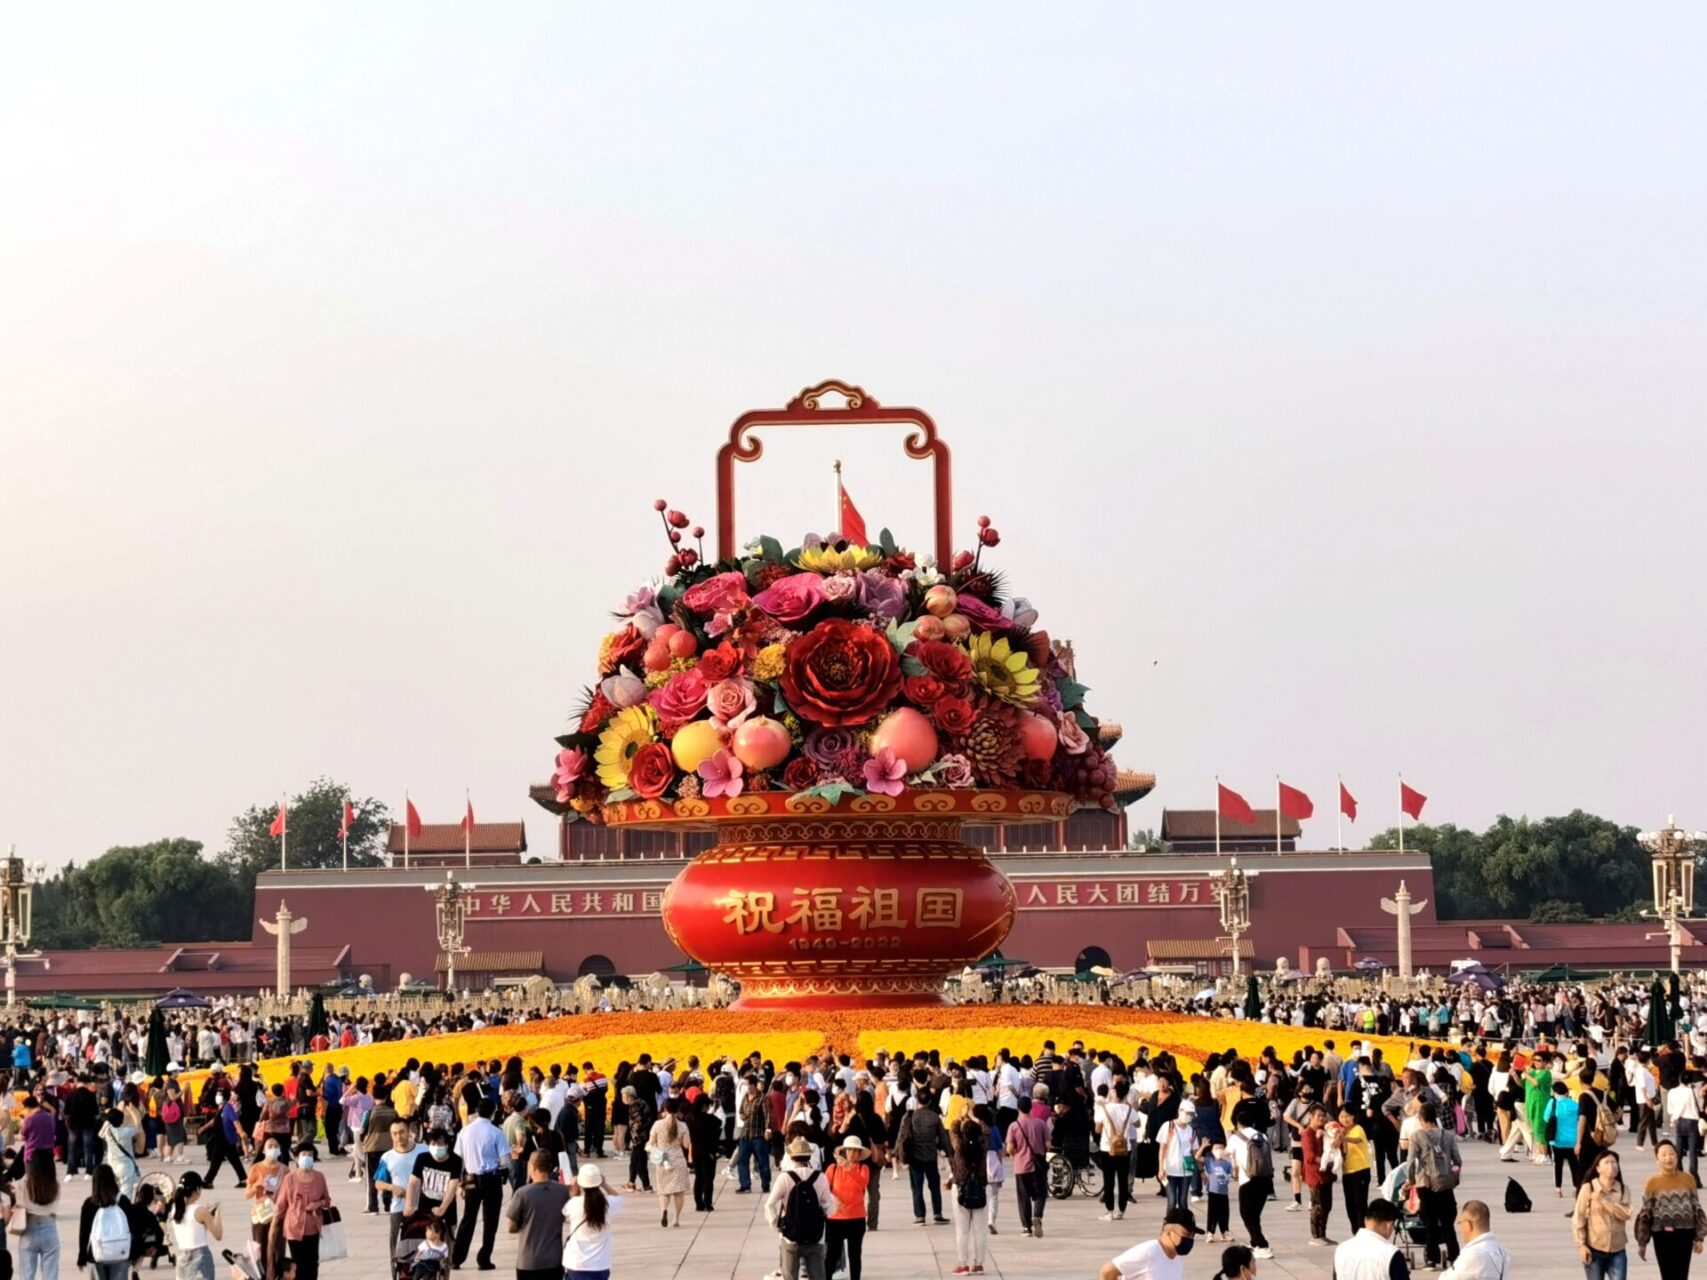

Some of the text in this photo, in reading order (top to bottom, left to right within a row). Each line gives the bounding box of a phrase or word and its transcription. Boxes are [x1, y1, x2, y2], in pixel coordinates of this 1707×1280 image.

[460, 890, 663, 916] 中华人民共和国
[722, 886, 964, 935] 祝福祖国
[788, 936, 902, 950] 1949-2022
